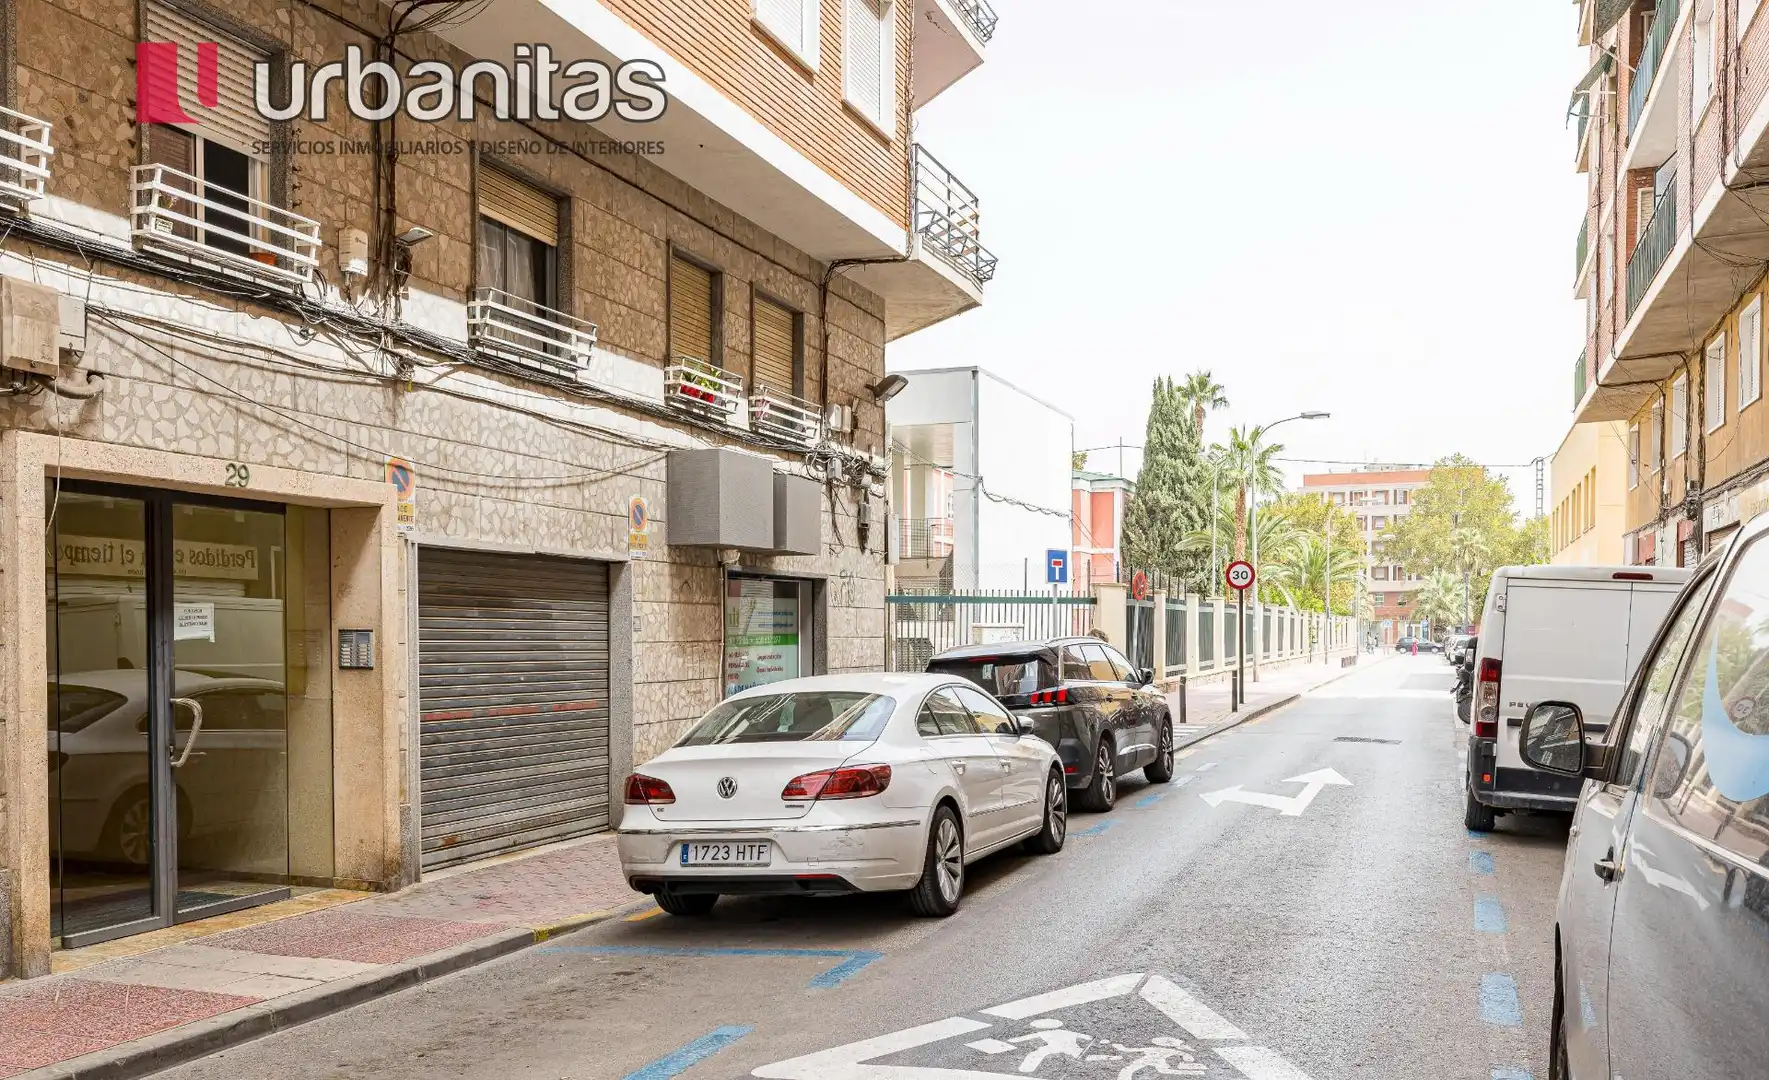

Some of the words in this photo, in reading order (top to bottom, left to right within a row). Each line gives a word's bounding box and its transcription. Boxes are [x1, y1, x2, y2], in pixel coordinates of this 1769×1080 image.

[225, 463, 249, 488] 29
[1233, 570, 1249, 580] 30
[694, 845, 730, 860] 1723
[736, 845, 768, 860] HTF
